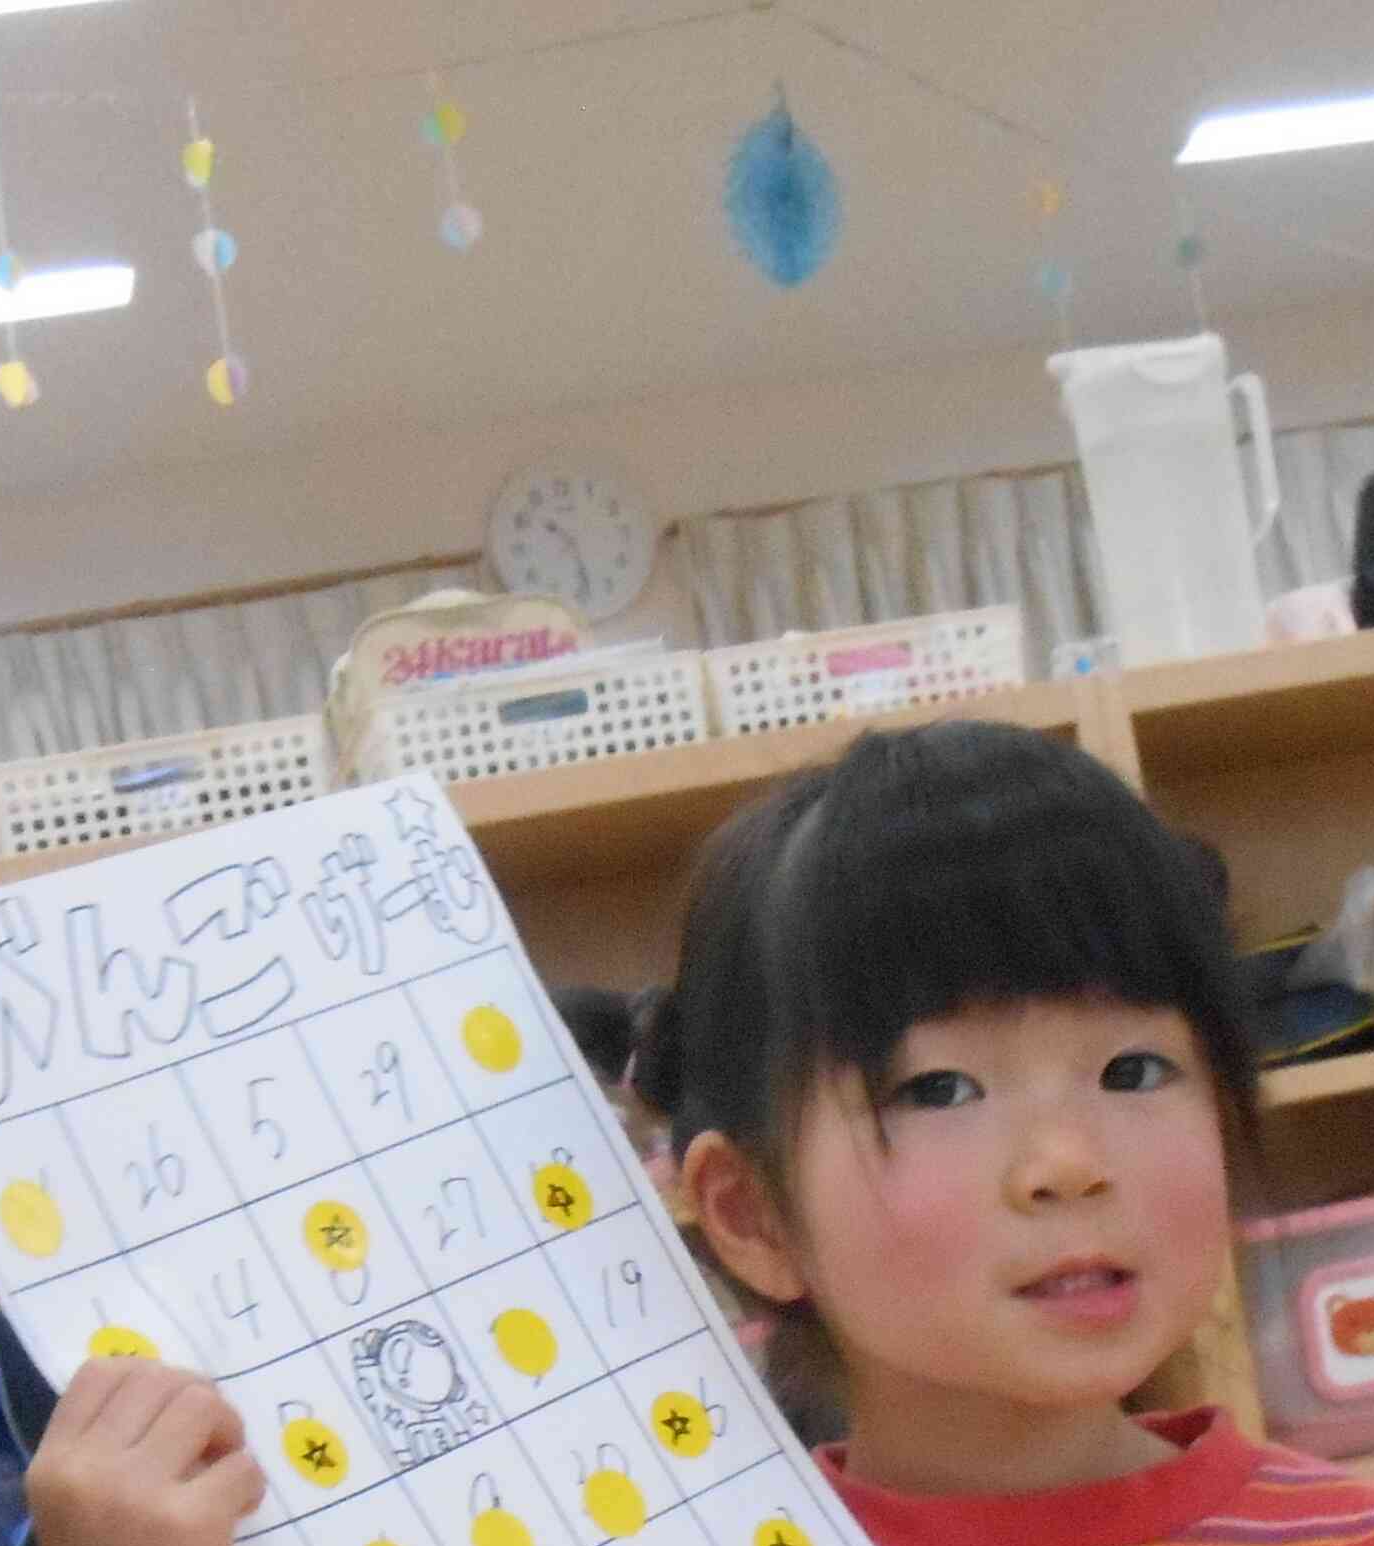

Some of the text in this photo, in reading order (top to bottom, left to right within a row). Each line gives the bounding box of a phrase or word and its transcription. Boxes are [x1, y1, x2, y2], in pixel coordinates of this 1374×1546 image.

[124, 1040, 414, 1213] 26 5 29
[424, 1176, 486, 1251] 27
[601, 1258, 647, 1329] 19
